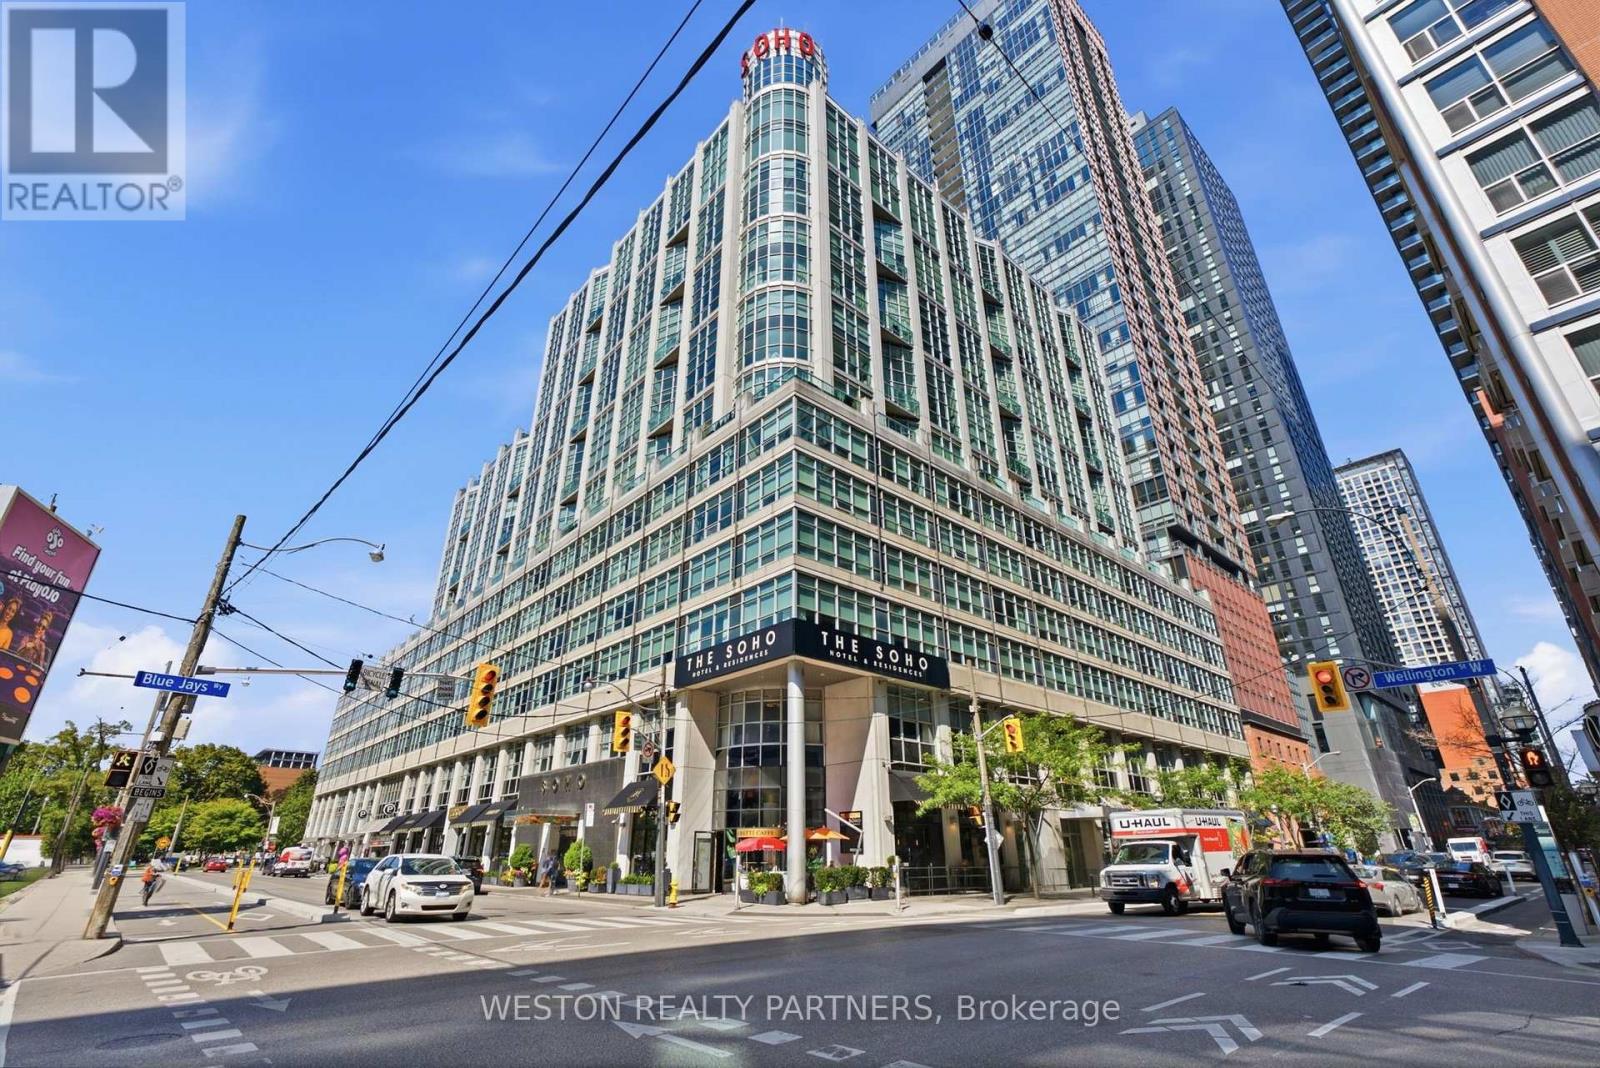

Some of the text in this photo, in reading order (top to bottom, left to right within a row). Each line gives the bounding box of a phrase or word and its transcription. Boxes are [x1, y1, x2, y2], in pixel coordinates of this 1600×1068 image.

[12, 545, 37, 567] Find
[32, 560, 57, 579] your
[52, 570, 71, 588] fun
[687, 630, 776, 672] THE SOHO
[723, 649, 769, 668] RESIDENCES
[821, 631, 928, 671] THE SOHO
[829, 649, 858, 662] HOTEL
[873, 660, 923, 678] RESIDENCES
[1384, 666, 1455, 683] Wellington
[1469, 662, 1482, 673] W
[142, 673, 174, 688] Blue
[178, 679, 208, 694] Jays
[133, 788, 162, 797] BEGINS
[1119, 817, 1171, 829] U-HAUL
[1194, 816, 1221, 827] U-HAUL
